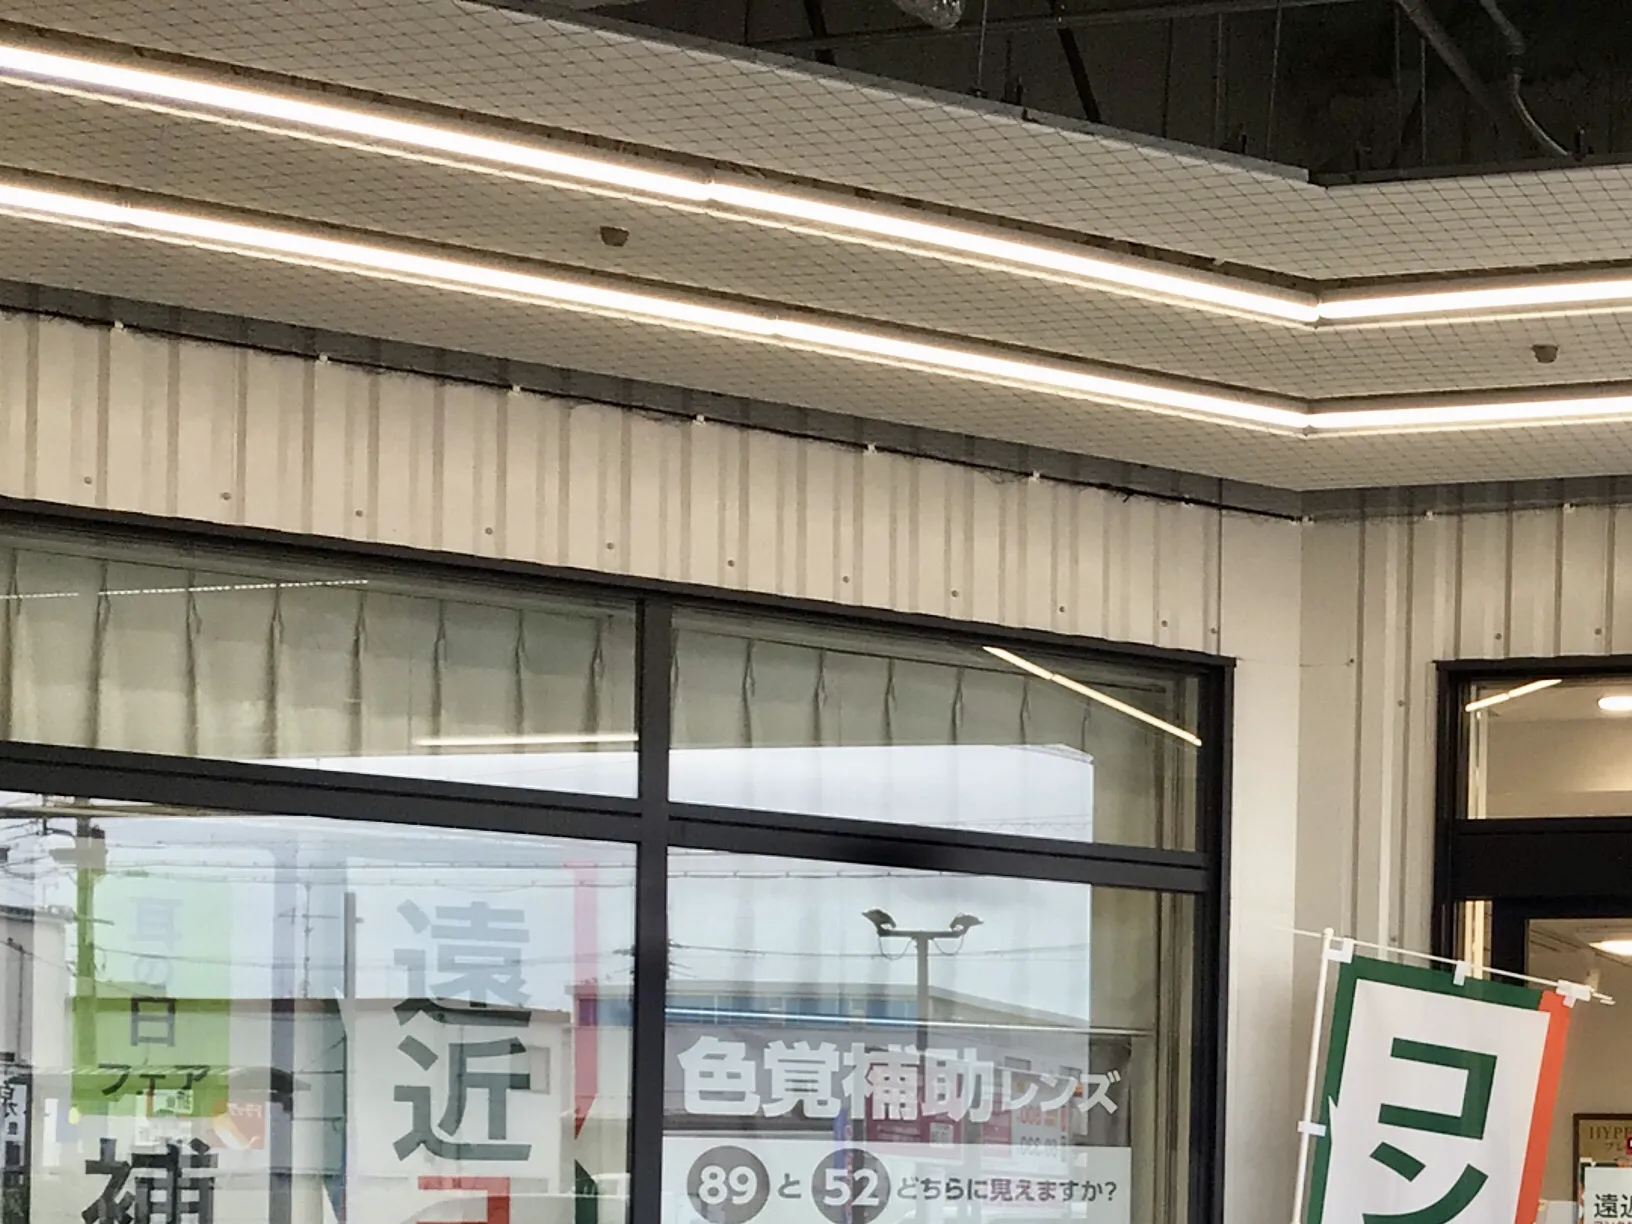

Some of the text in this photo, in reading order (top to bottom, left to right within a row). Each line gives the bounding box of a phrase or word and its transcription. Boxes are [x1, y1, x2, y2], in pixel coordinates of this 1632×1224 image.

[677, 1034, 1121, 1123] 色覚補助レンズ
[699, 1166, 758, 1206] 89
[824, 1168, 880, 1206] 52
